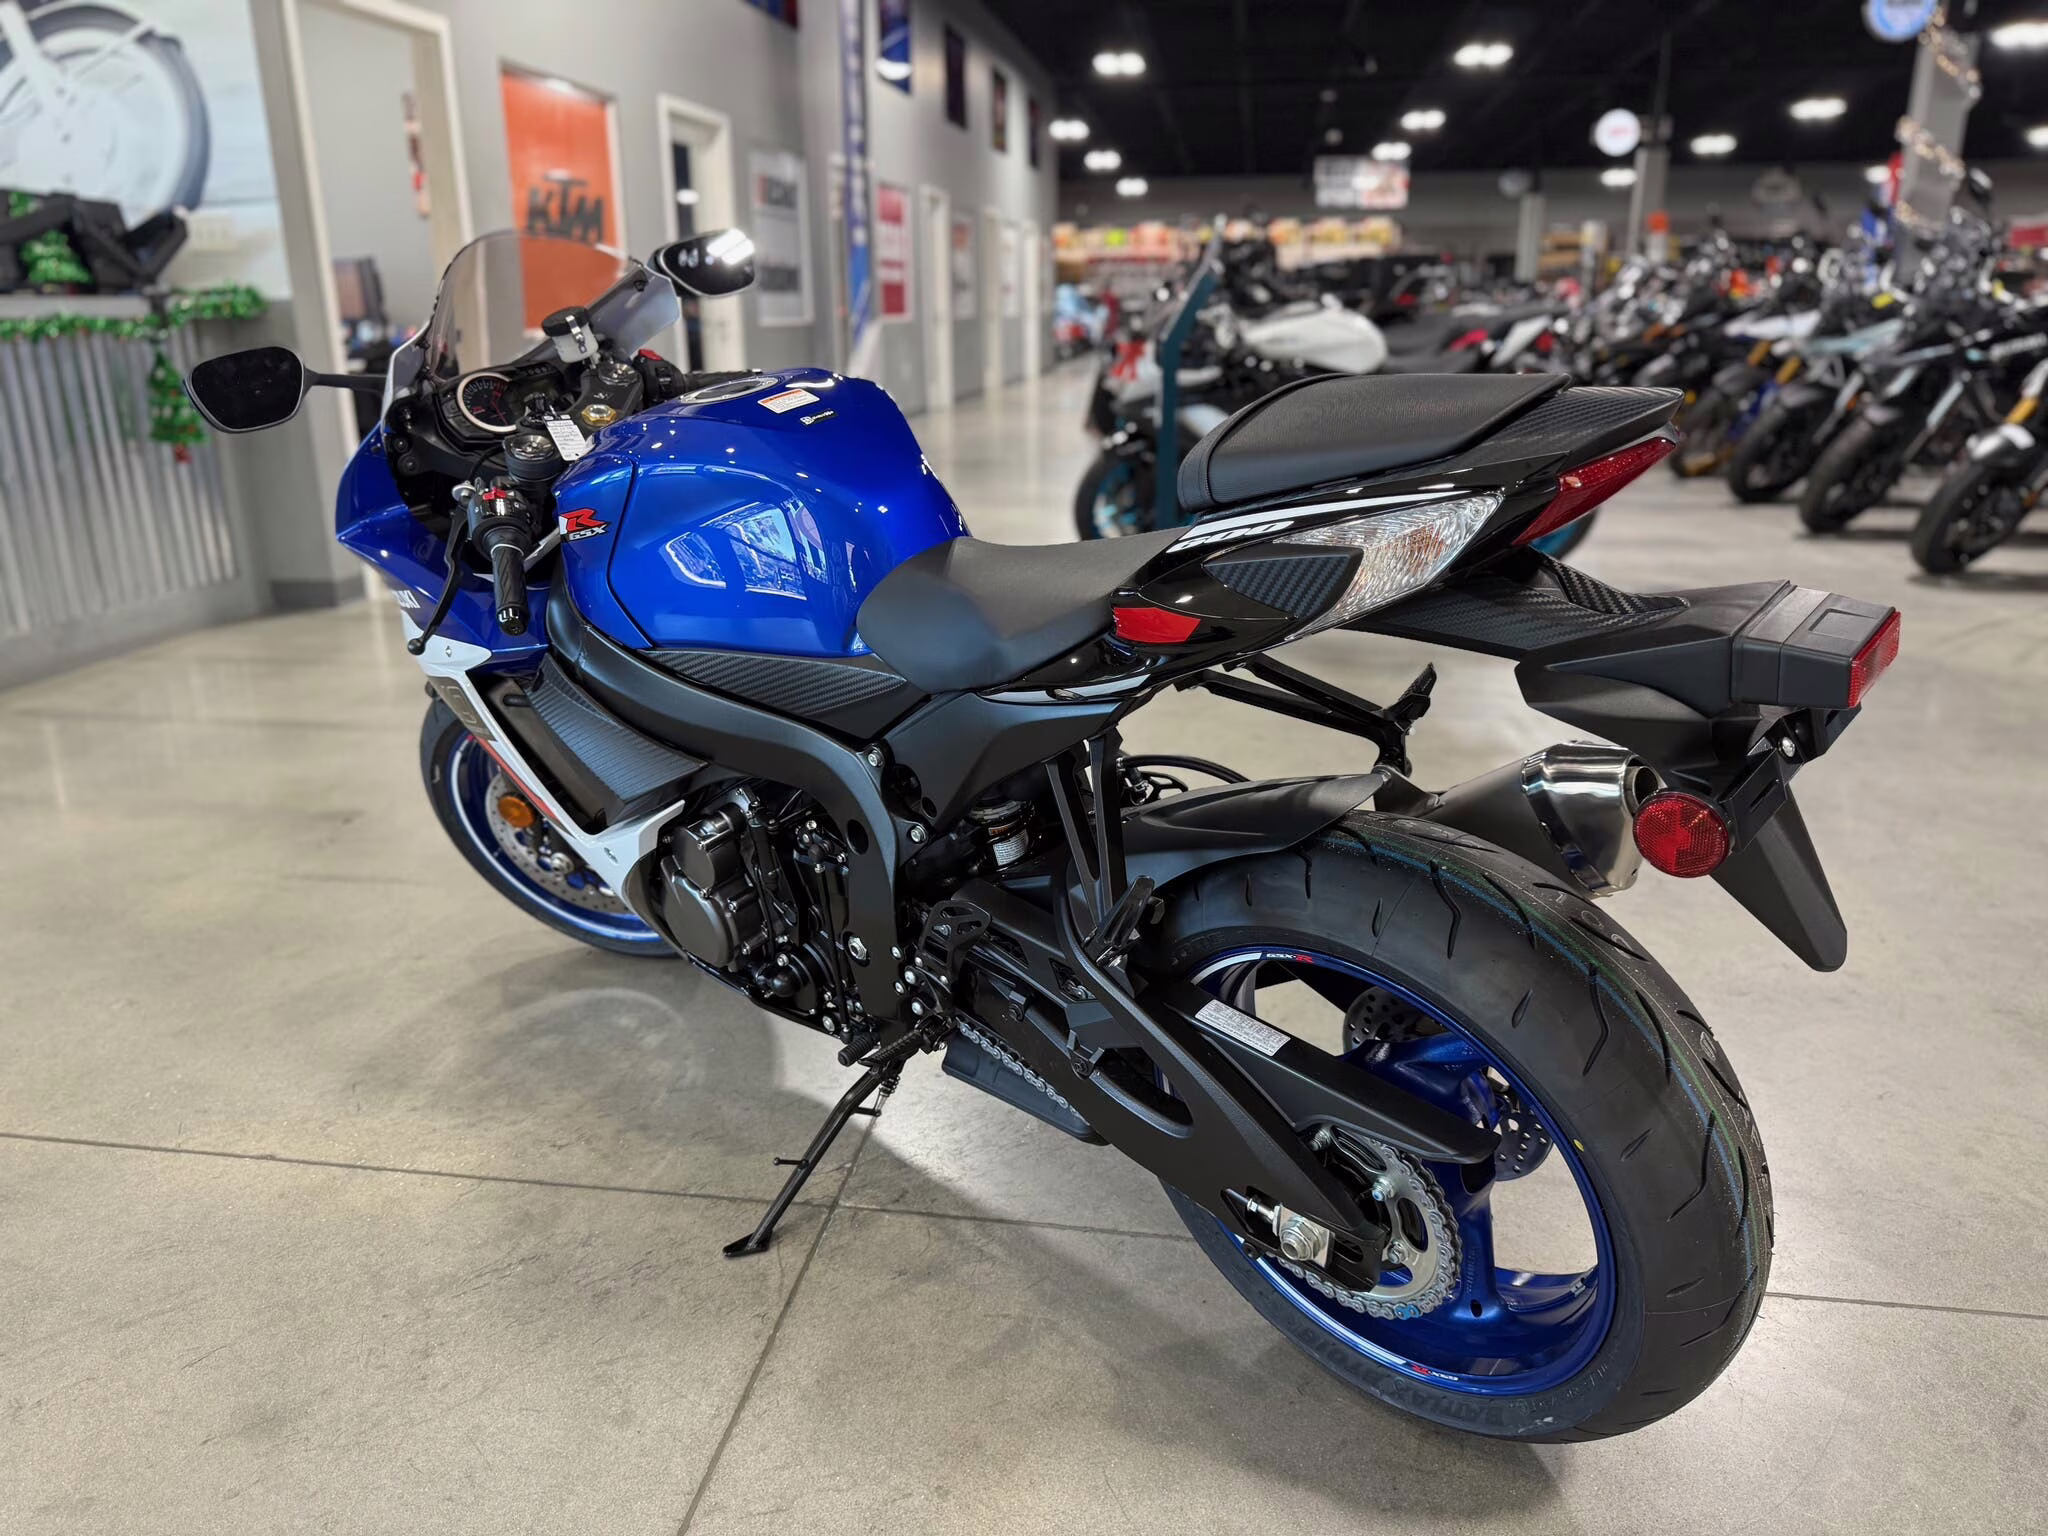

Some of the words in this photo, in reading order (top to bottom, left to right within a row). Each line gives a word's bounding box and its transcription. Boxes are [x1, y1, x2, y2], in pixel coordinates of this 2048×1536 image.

[526, 174, 604, 245] KTM
[569, 524, 607, 541] GSX
[1166, 520, 1295, 553] 600
